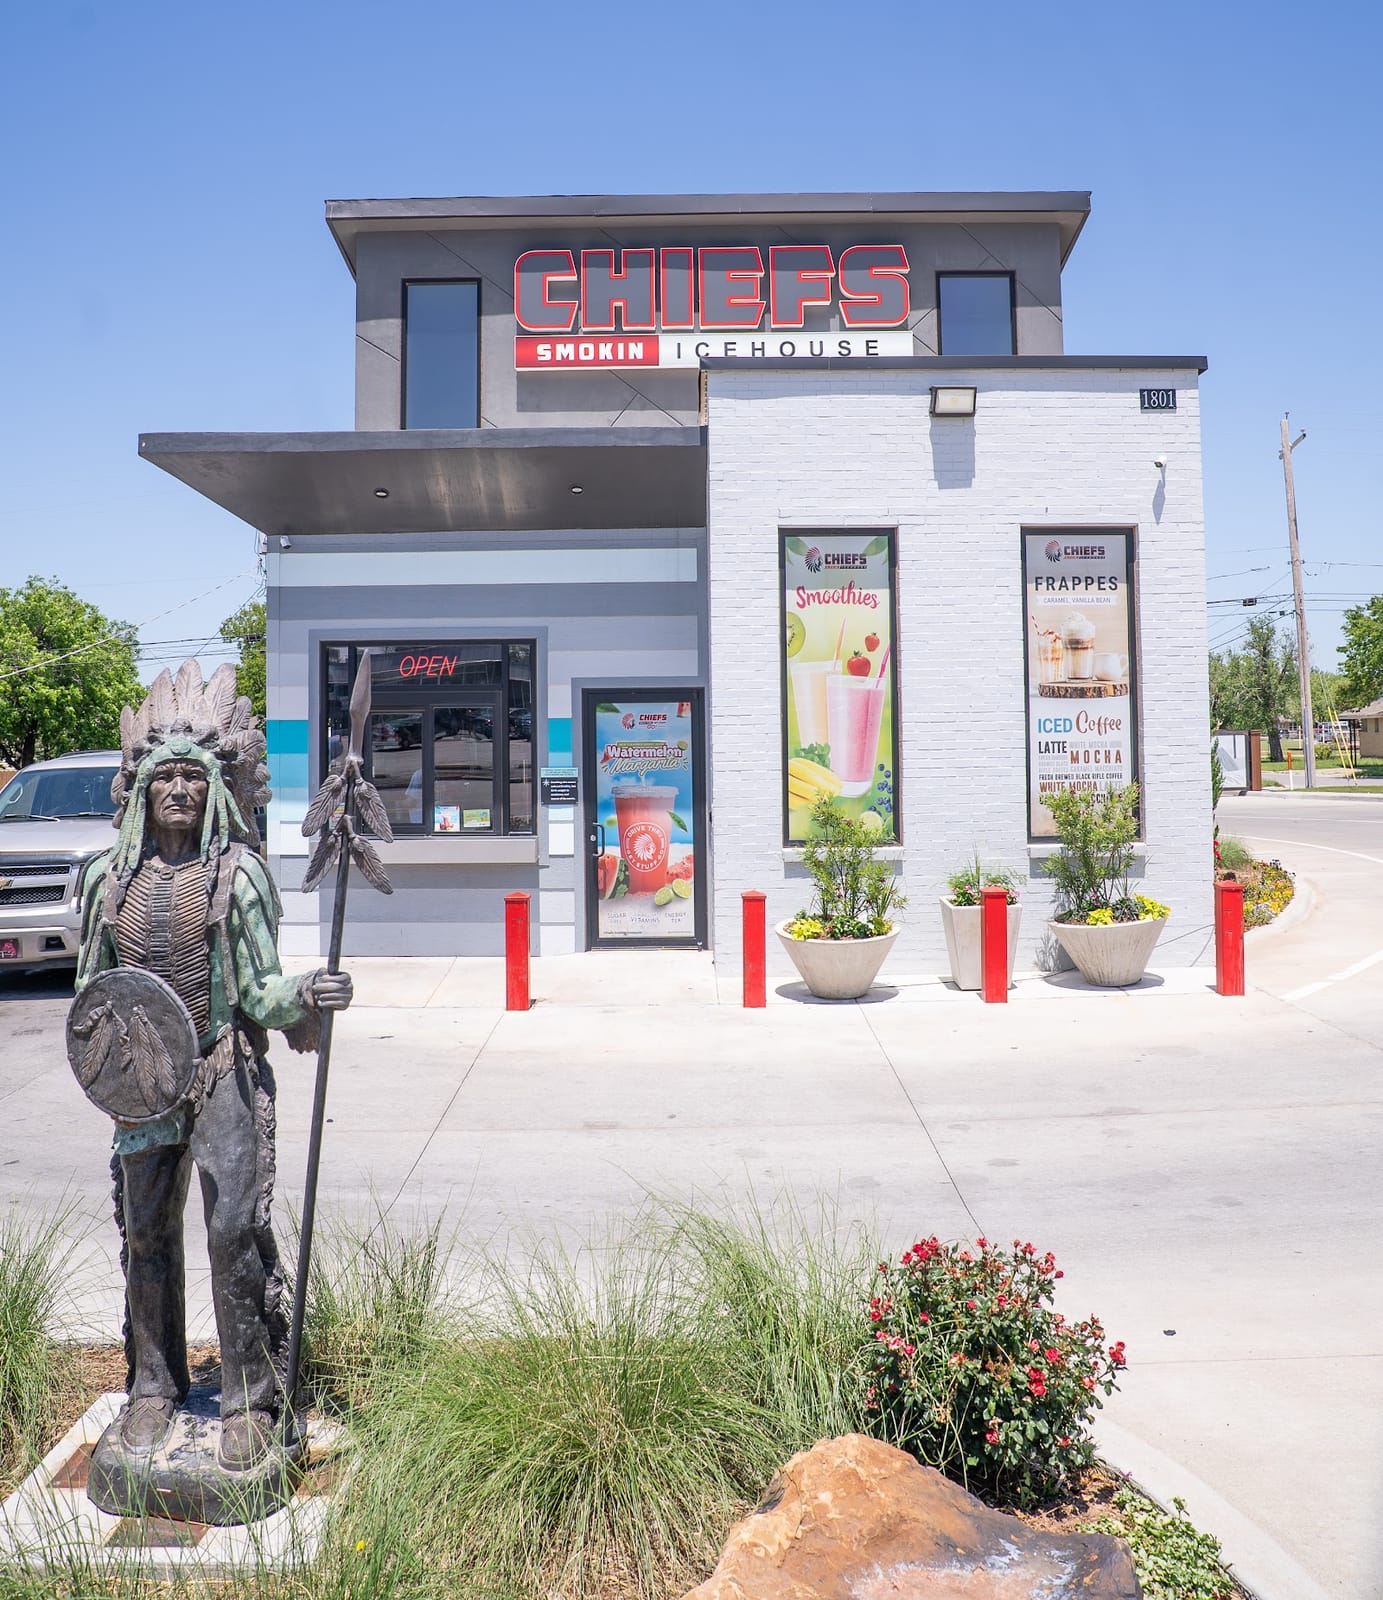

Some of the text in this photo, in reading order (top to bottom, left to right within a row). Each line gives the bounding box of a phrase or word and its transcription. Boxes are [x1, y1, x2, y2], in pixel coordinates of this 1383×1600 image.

[514, 244, 911, 333] CHIEFS
[537, 339, 880, 361] SMOKIN ICEHOUSE
[1142, 390, 1175, 408] 1801
[825, 553, 867, 565] CHIEFS
[1064, 546, 1105, 556] CHIEFS
[1035, 576, 1118, 591] FRAPPES
[796, 580, 880, 609] Smoothies
[400, 655, 457, 678] OPEN
[1038, 710, 1122, 736] ICED Coffee
[606, 744, 682, 759] Watermelon
[1038, 741, 1067, 754] LATTE
[1070, 749, 1122, 764] MOCHA
[610, 757, 680, 777] Margarita
